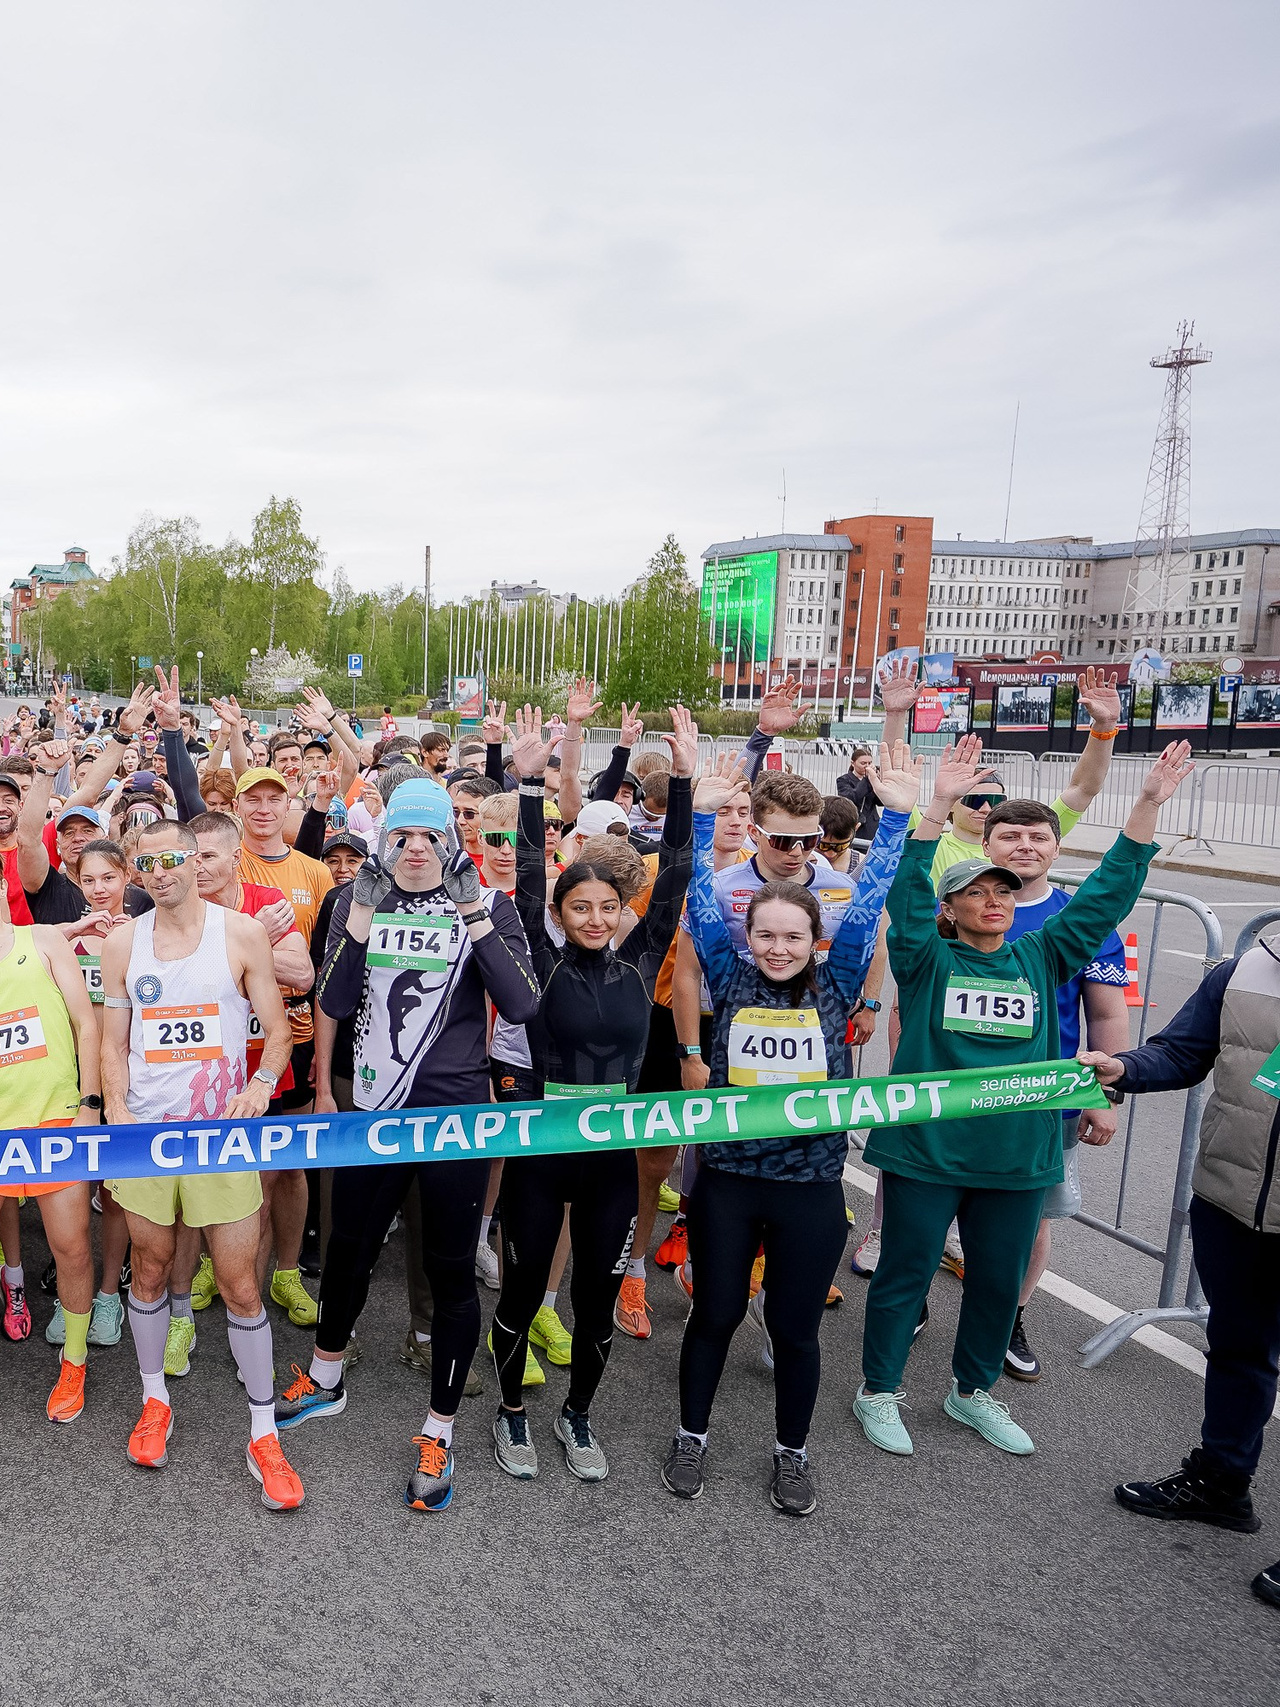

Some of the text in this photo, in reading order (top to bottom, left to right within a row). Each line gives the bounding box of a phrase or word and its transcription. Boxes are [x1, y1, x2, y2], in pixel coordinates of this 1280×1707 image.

[706, 567, 752, 581] РЕОРДНЫЕ
[352, 656, 360, 669] P
[1224, 677, 1239, 692] P
[396, 804, 435, 812] открытие
[292, 888, 306, 896] MAN
[292, 895, 311, 905] STAR
[378, 928, 441, 954] 1154
[956, 993, 1026, 1020] 1153
[158, 1021, 206, 1045] 238
[741, 1035, 813, 1061] 4001
[980, 1070, 1058, 1092] зелёный
[971, 1089, 1049, 1109] марафон
[150, 1122, 330, 1169] СТАРТ
[367, 1109, 543, 1155] СТАРТ
[578, 1094, 749, 1143] СТАРТ
[783, 1079, 951, 1129] СТАРТ
